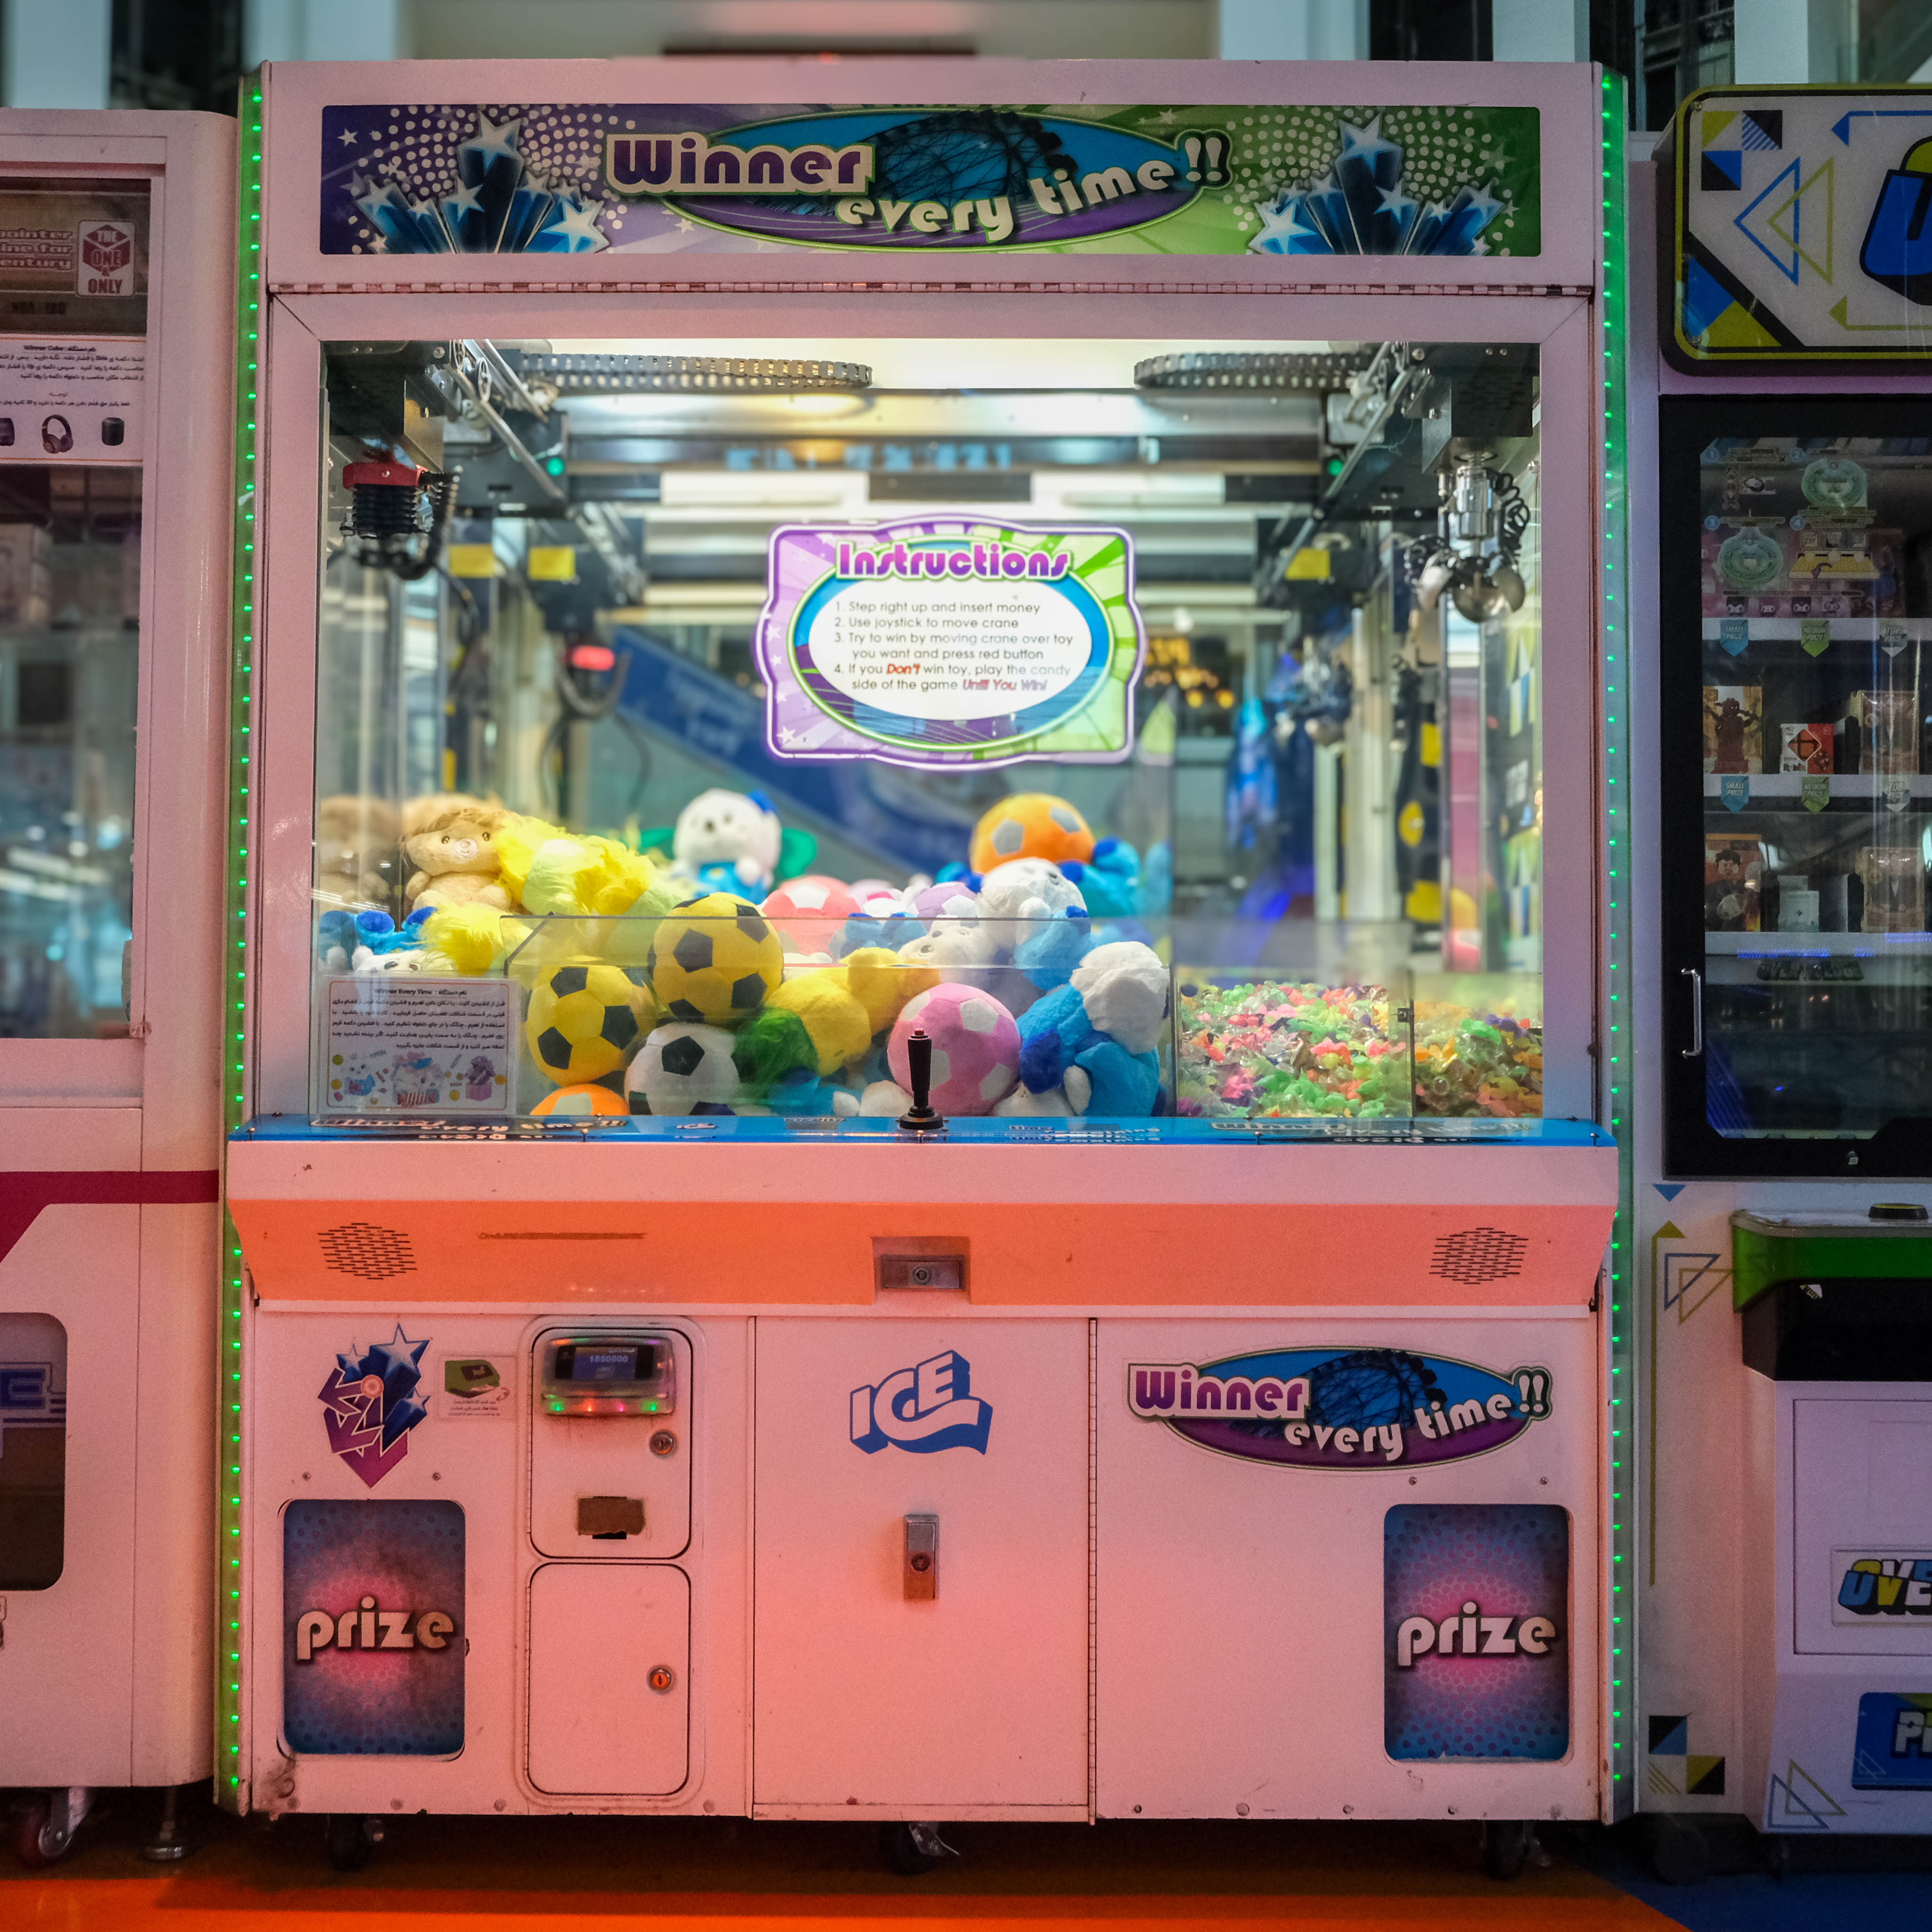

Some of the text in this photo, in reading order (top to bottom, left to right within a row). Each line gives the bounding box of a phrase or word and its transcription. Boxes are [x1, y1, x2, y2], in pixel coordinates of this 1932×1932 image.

[613, 138, 863, 186] Winner
[837, 196, 1015, 243] every
[91, 250, 121, 267] ONE
[88, 279, 123, 294] ONLY
[838, 542, 1069, 577] Instructions
[848, 601, 876, 613] Step
[880, 602, 907, 614] right
[911, 604, 927, 614] up
[931, 602, 956, 612] and
[960, 603, 992, 612] insert
[997, 605, 1040, 614] money
[849, 617, 871, 628] Use
[874, 617, 922, 629] joystick
[927, 618, 938, 628] to
[982, 620, 1019, 628] crane
[849, 632, 865, 644] Try
[870, 633, 881, 643] to
[886, 633, 906, 643] win
[910, 633, 926, 645] by
[930, 633, 977, 645] moving
[981, 635, 1018, 644] crane
[1021, 635, 1050, 644] over
[1054, 634, 1073, 646] toy
[853, 649, 1044, 660] you want and press red button
[848, 664, 856, 674] If
[859, 666, 883, 675] you
[886, 663, 921, 675] Don't
[923, 664, 944, 674] win
[949, 664, 971, 676] toy,
[975, 664, 1003, 676] play
[1007, 665, 1026, 674] the
[1030, 664, 1071, 677] candy
[852, 679, 877, 689] side
[881, 679, 893, 689] of
[897, 679, 916, 689] the
[921, 681, 958, 692] game
[993, 679, 1017, 691] You
[850, 1349, 993, 1455] ICE
[1134, 1369, 1303, 1412] Winner
[1284, 1421, 1404, 1461] every
[297, 1595, 454, 1660] prize
[1398, 1601, 1556, 1667] prize
